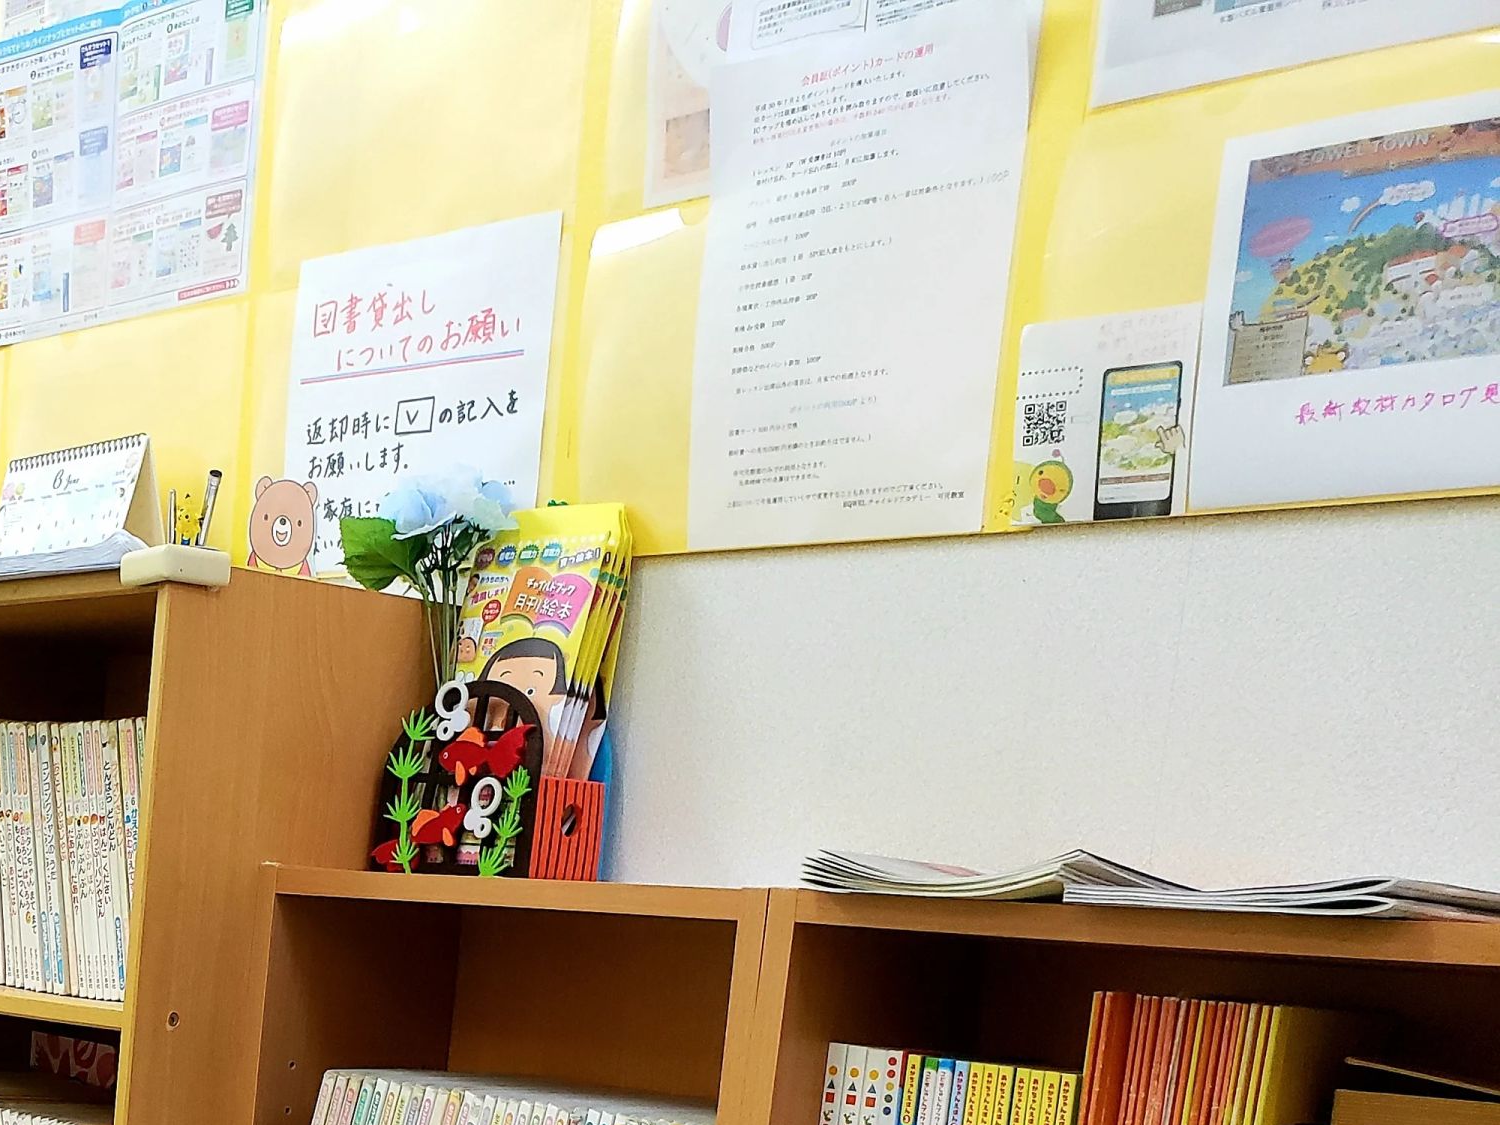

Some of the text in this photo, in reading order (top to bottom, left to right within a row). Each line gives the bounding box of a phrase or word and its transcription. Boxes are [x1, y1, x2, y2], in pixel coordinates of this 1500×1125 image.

[1373, 133, 1430, 151] TOWN
[336, 308, 521, 372] についてのお願い
[306, 411, 391, 446] 返却時に
[439, 390, 519, 426] の記入を
[308, 443, 409, 479] お願いします。
[526, 578, 576, 595] チャイルドブック
[513, 594, 573, 620] 月刊絵本
